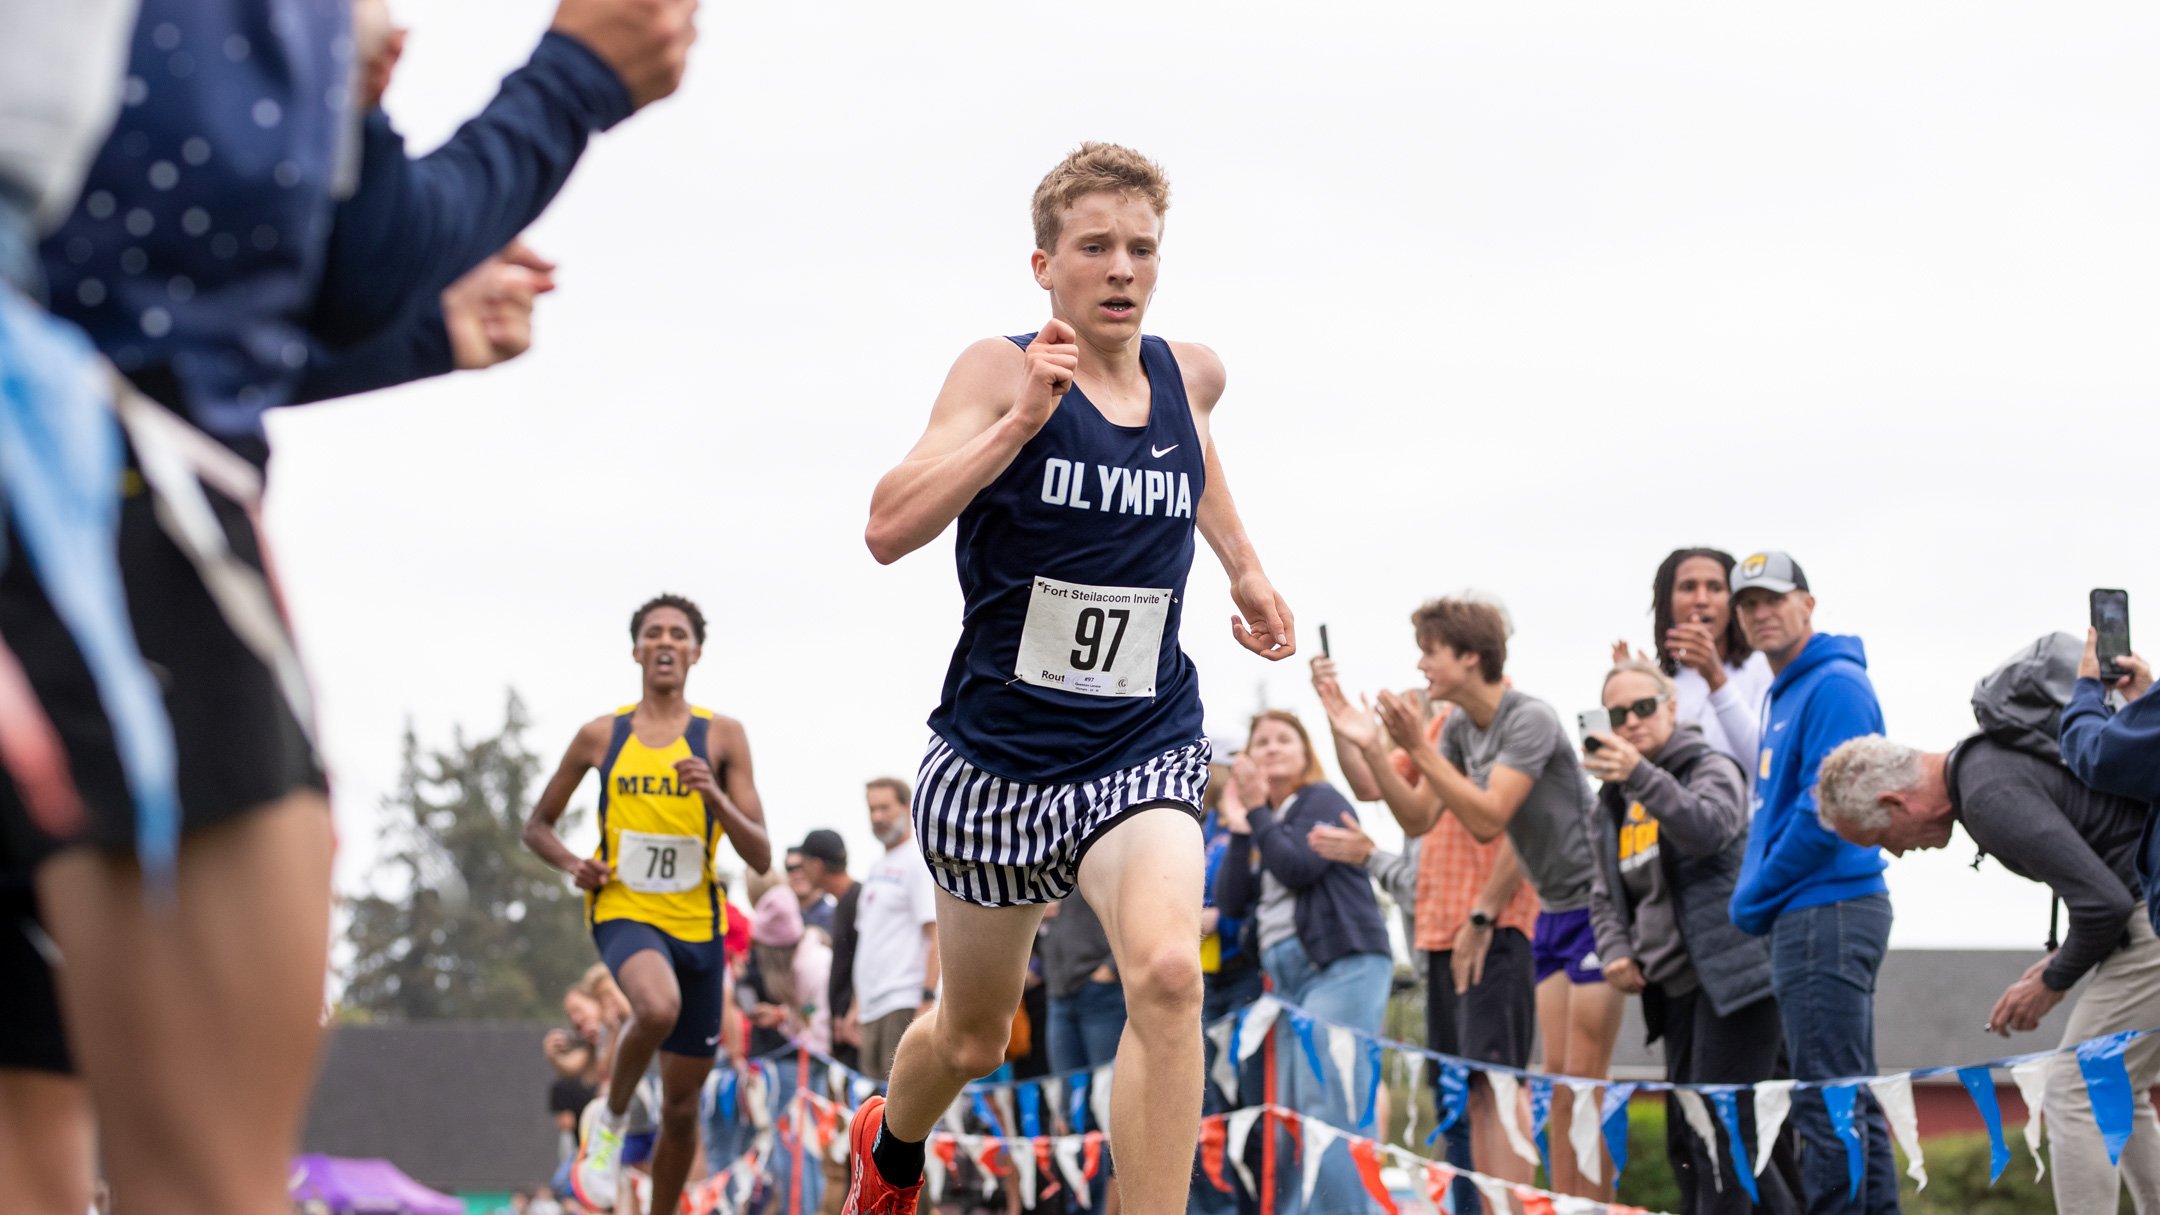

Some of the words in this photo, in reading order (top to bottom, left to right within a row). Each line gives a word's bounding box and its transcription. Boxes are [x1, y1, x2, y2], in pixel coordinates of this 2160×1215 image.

[1041, 457, 1192, 519] OLYMPIA
[1043, 584, 1068, 598] Fort
[1071, 589, 1131, 603] Steilacoom
[1133, 593, 1160, 604] Invite
[1070, 607, 1130, 673] 97
[646, 846, 677, 879] 78
